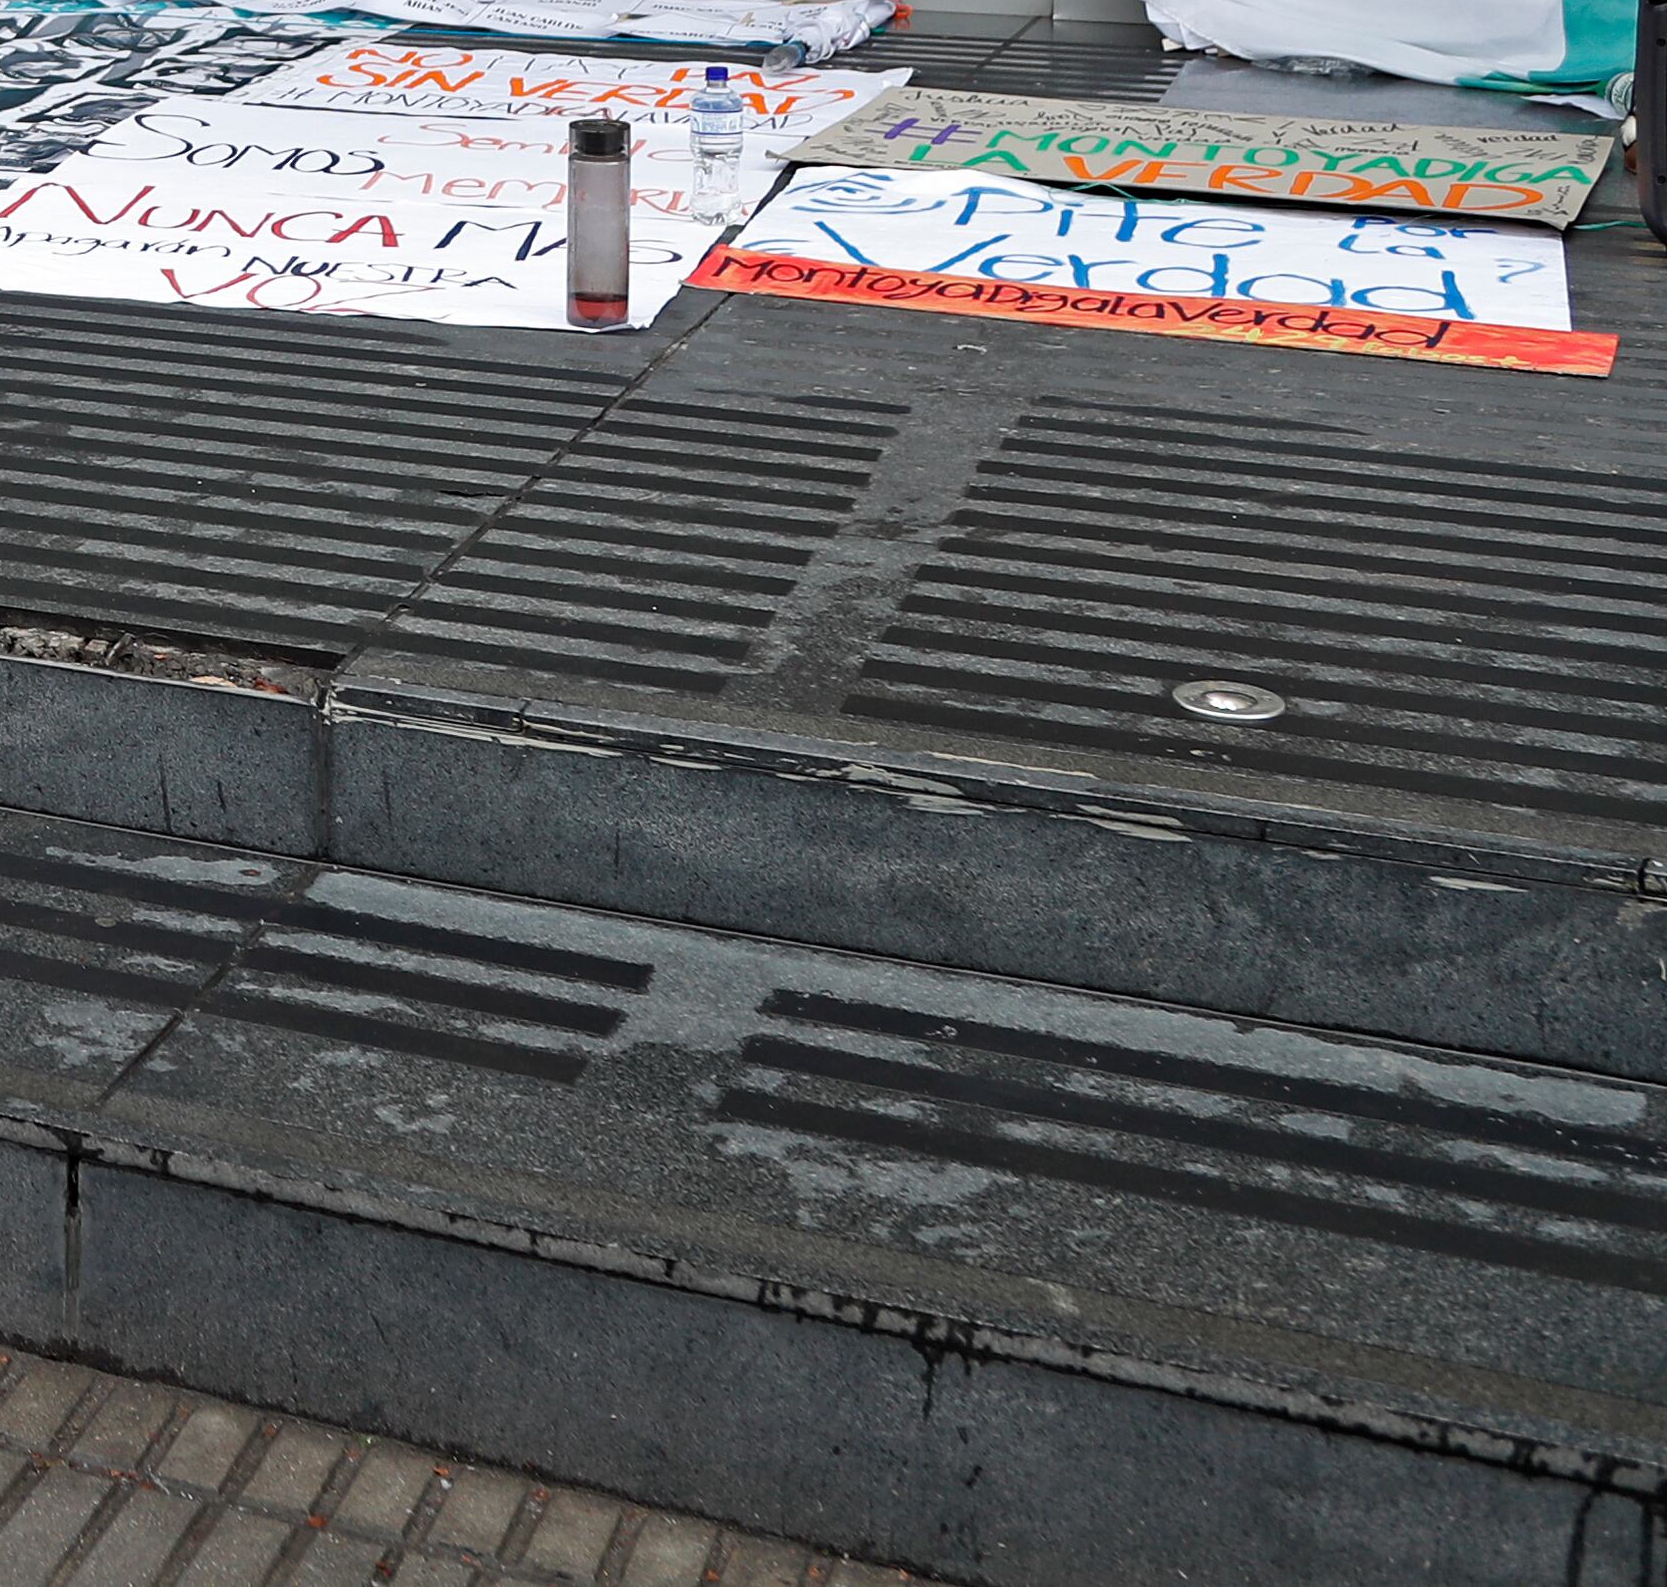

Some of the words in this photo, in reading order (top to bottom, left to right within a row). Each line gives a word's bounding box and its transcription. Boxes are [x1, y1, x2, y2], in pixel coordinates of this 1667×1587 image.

[492, 6, 527, 20] JUAN
[343, 46, 474, 67] NO
[316, 61, 485, 94] SIN
[909, 144, 1030, 172] LA
[1063, 155, 1544, 211] VERDAD
